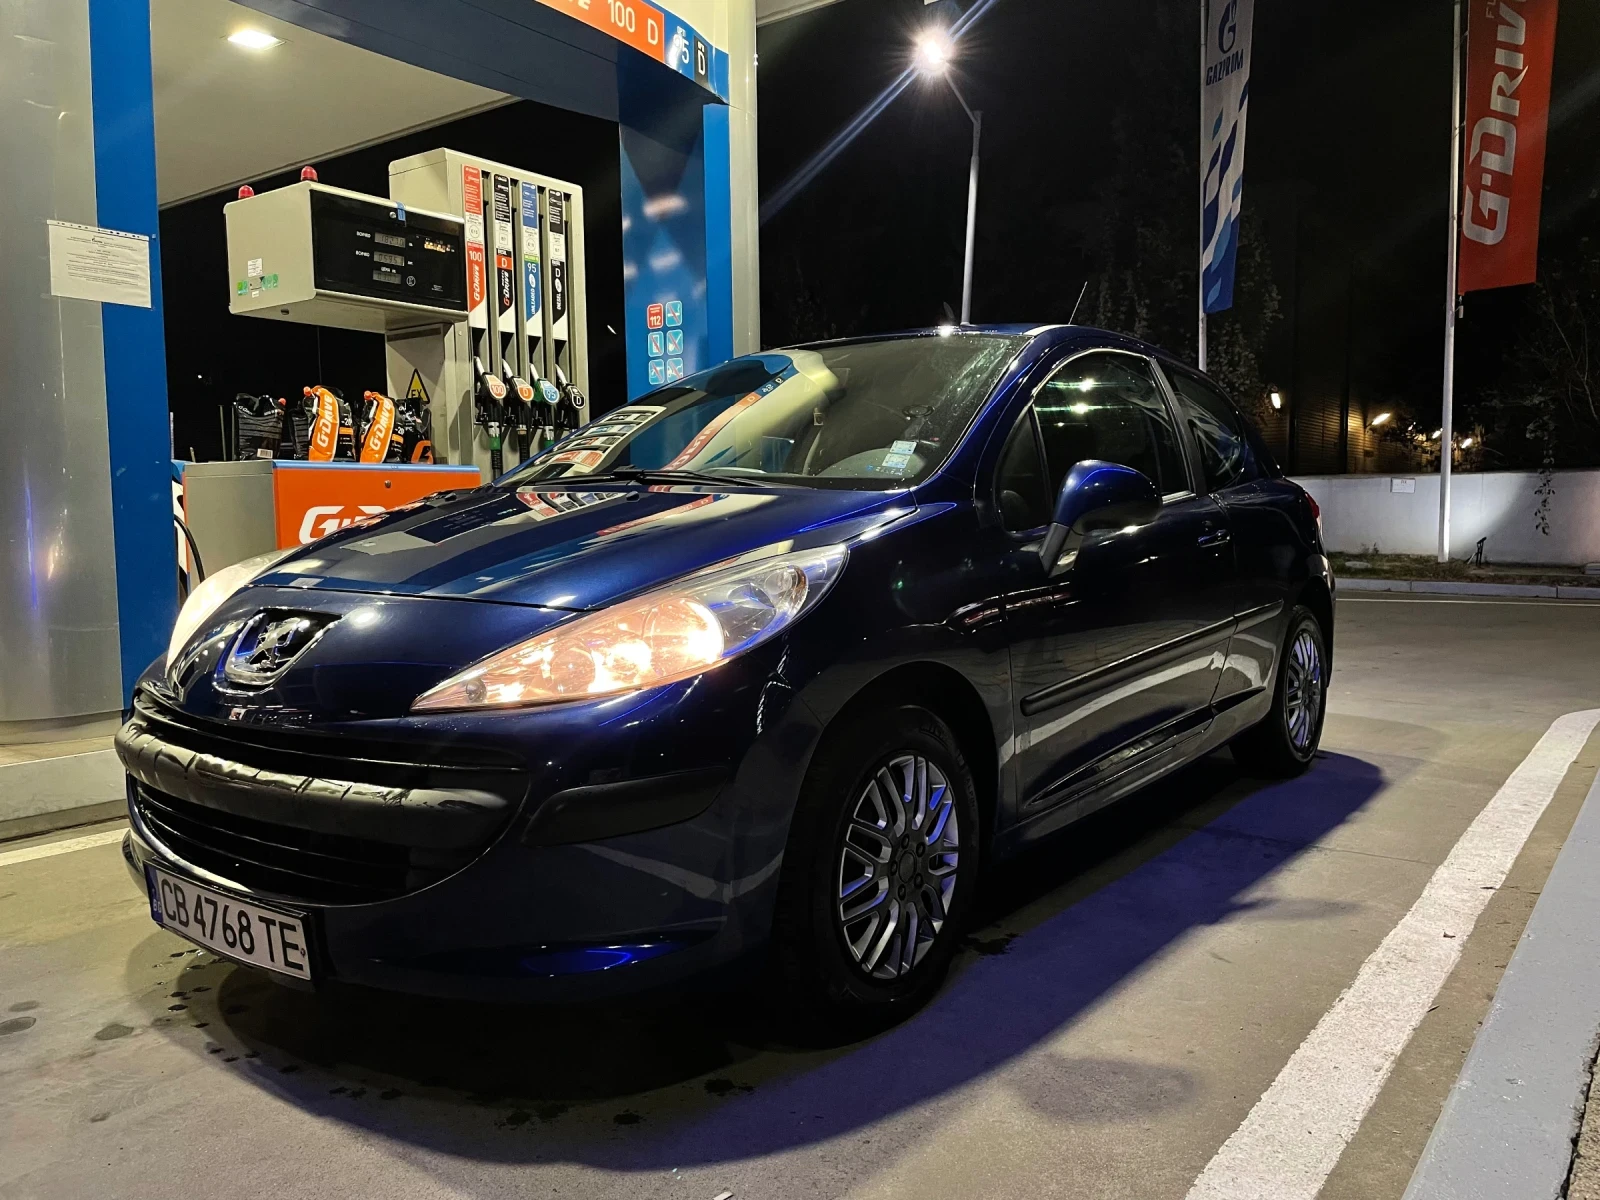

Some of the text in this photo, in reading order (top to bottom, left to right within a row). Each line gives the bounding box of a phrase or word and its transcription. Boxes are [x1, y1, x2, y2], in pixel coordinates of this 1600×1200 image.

[608, 0, 659, 46] 100 D
[698, 49, 706, 76] D
[469, 251, 482, 262] 100
[501, 258, 508, 268] D
[527, 263, 537, 273] 95
[555, 268, 561, 278] D
[649, 315, 661, 326] 112
[491, 384, 505, 395] 100
[522, 388, 529, 397] D
[575, 396, 582, 405] D
[152, 899, 162, 914] BG
[161, 878, 304, 971] CB 4768 TE
